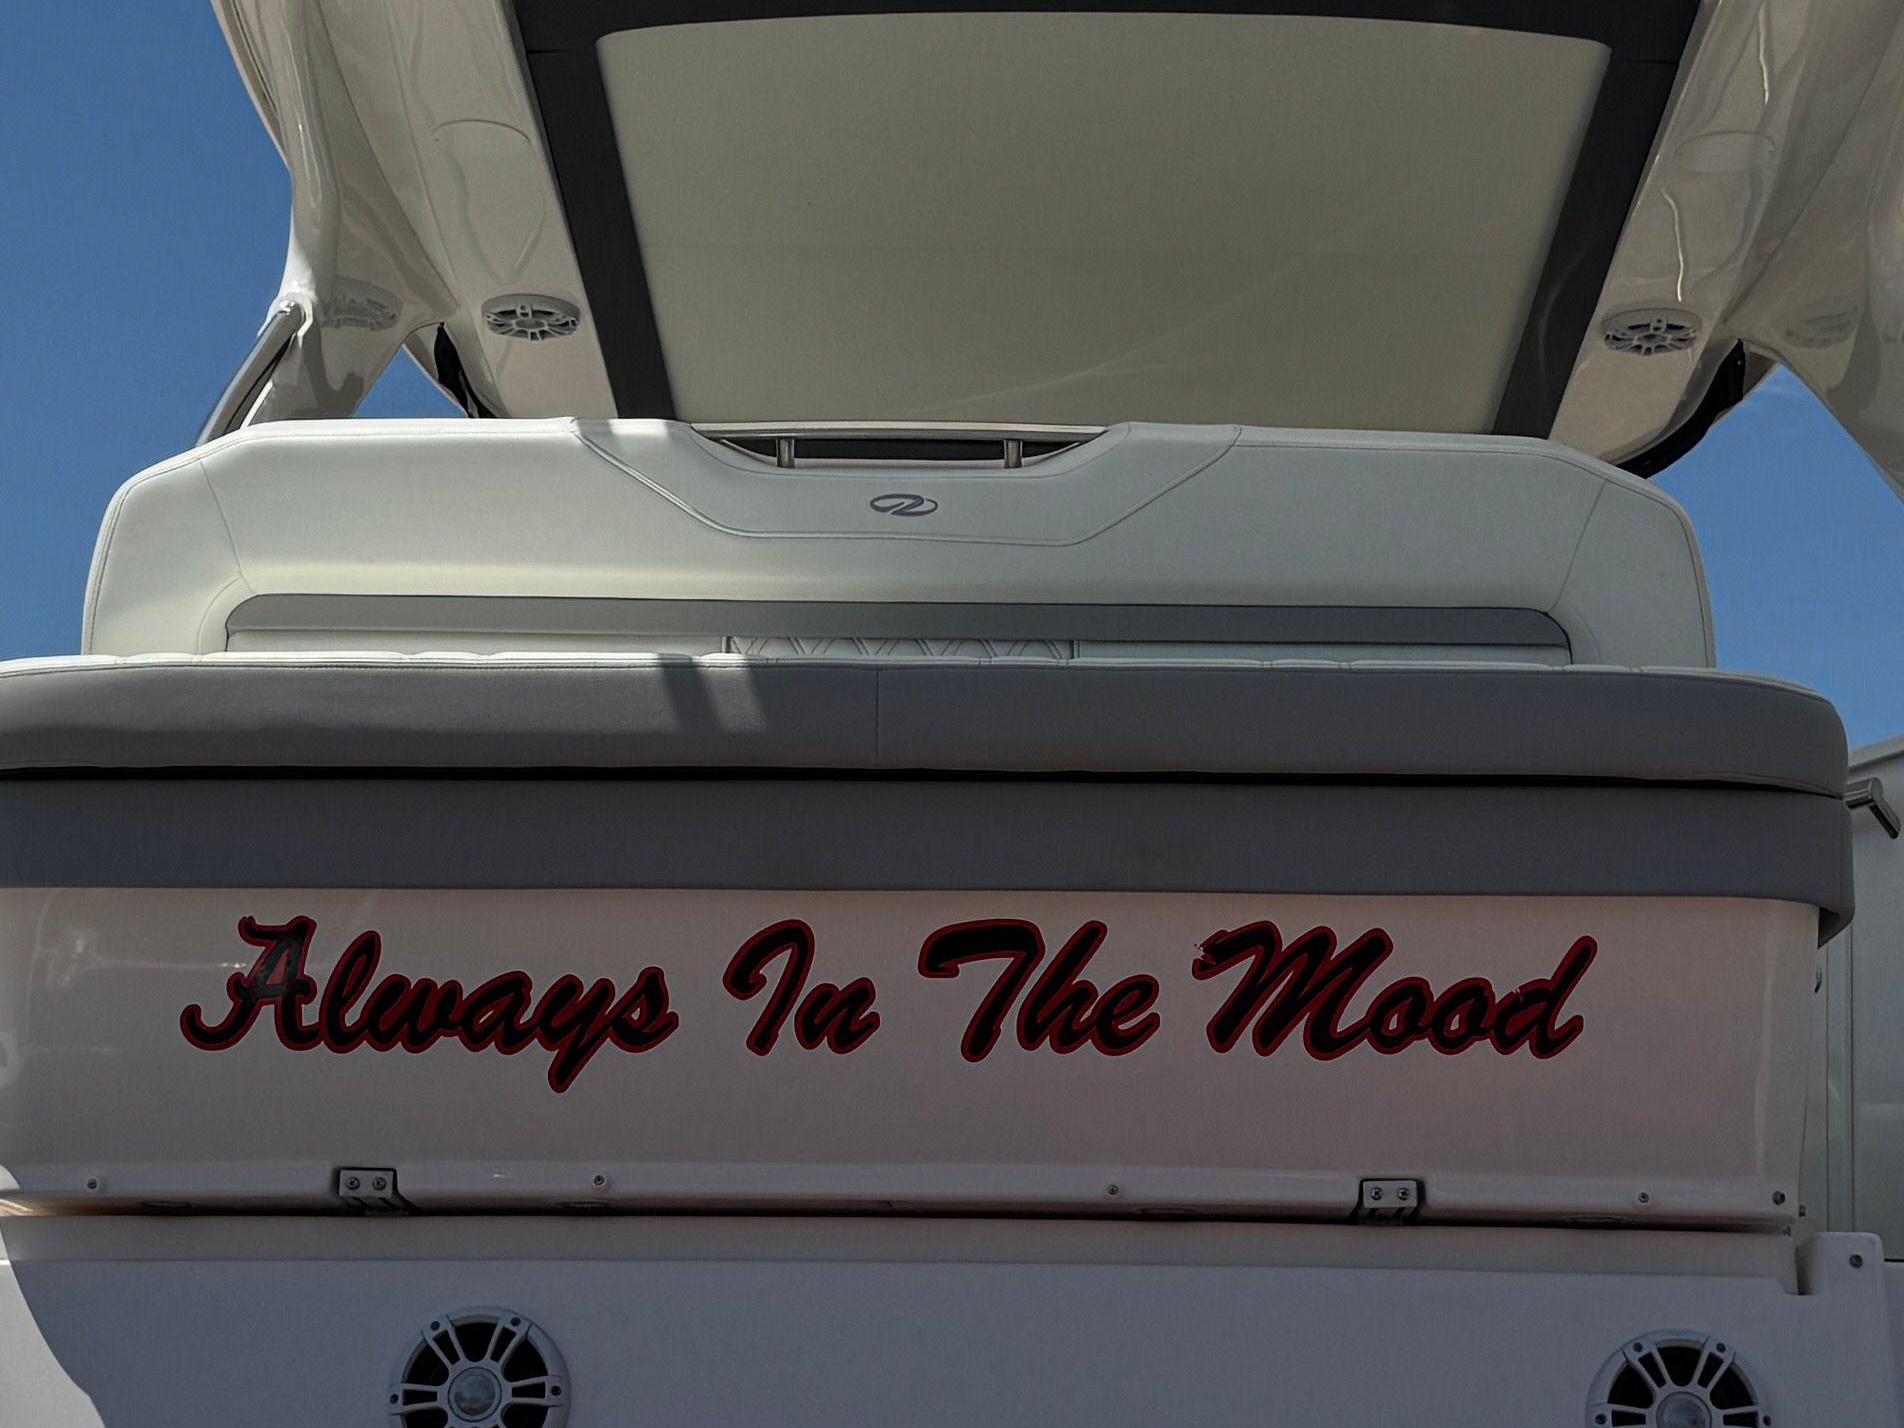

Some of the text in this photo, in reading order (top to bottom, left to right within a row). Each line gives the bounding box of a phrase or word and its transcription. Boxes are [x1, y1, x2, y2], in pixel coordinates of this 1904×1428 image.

[180, 915, 1598, 1094] Always In The Mood
